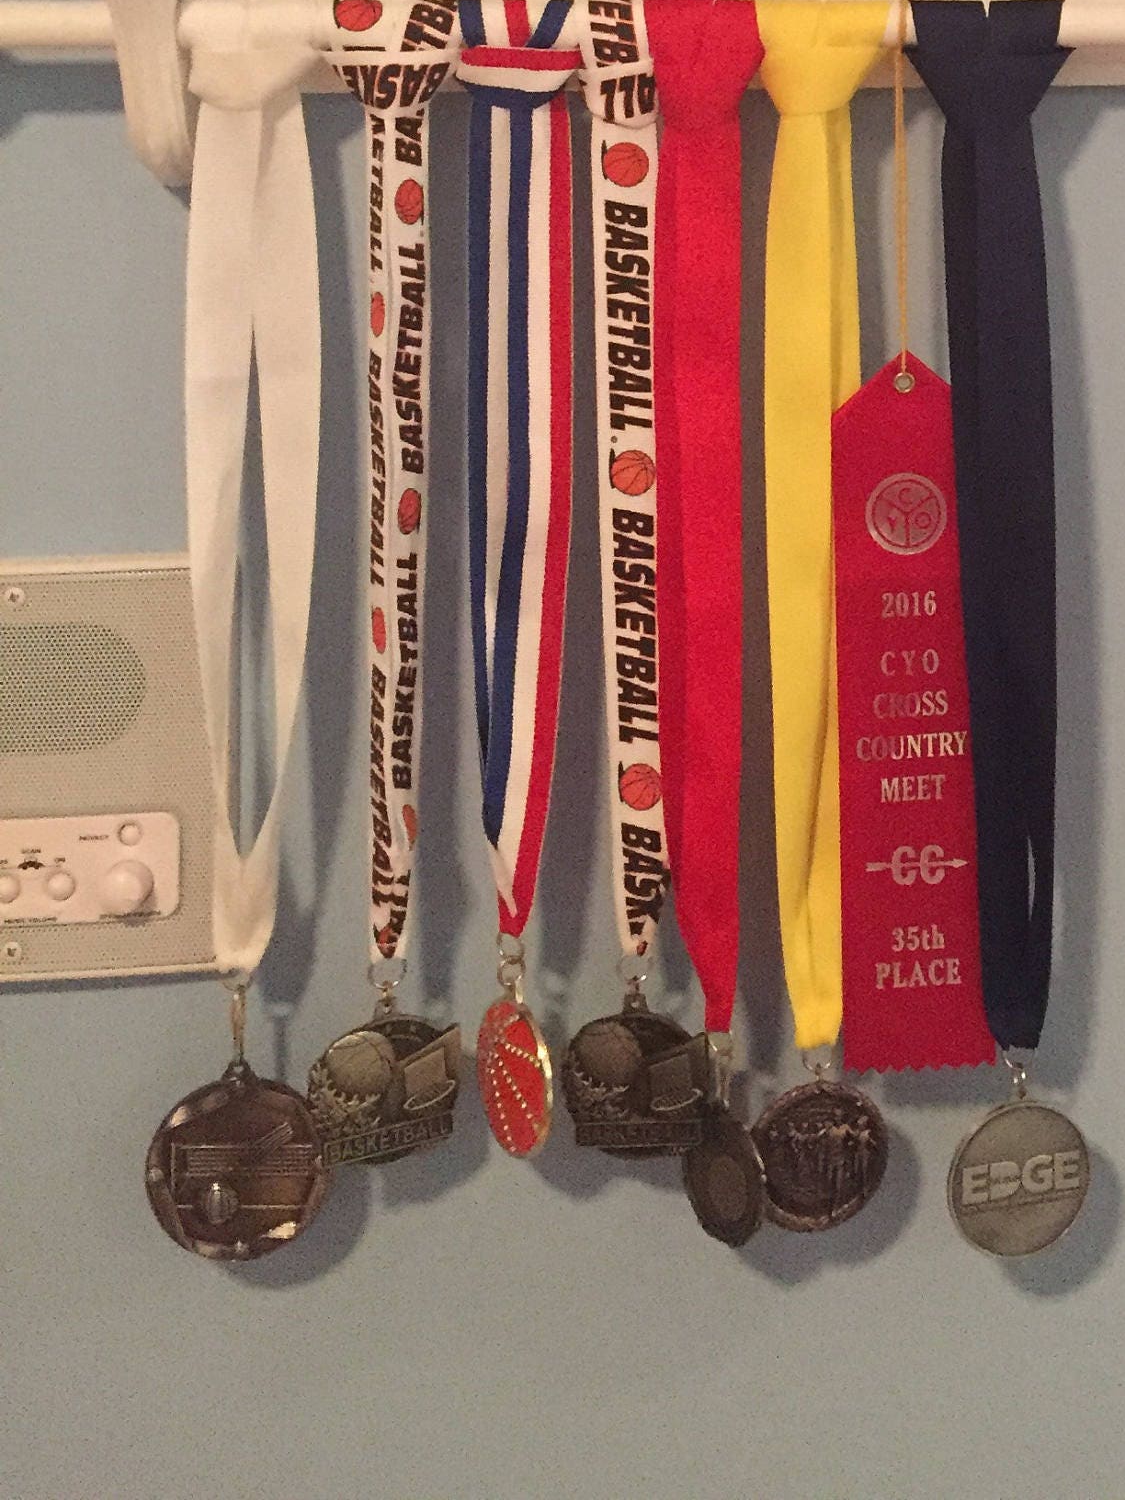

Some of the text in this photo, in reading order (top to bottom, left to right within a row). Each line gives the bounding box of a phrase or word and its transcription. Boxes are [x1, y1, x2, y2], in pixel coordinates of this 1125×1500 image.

[332, 61, 450, 110] BASKE
[604, 199, 653, 432] BASKETBALL
[392, 242, 427, 475] BASKETBALL
[611, 508, 659, 744] BASKETBALL
[881, 590, 937, 618] 2016
[391, 551, 418, 790] BASKETBALL
[873, 689, 949, 719] CROSS
[856, 730, 968, 761] COUNTRY
[880, 774, 946, 803] MEET
[891, 924, 945, 952] 35th
[875, 958, 962, 990] PLACE
[326, 1114, 451, 1164] BASKETBALL
[962, 1149, 1081, 1205] EDGE
